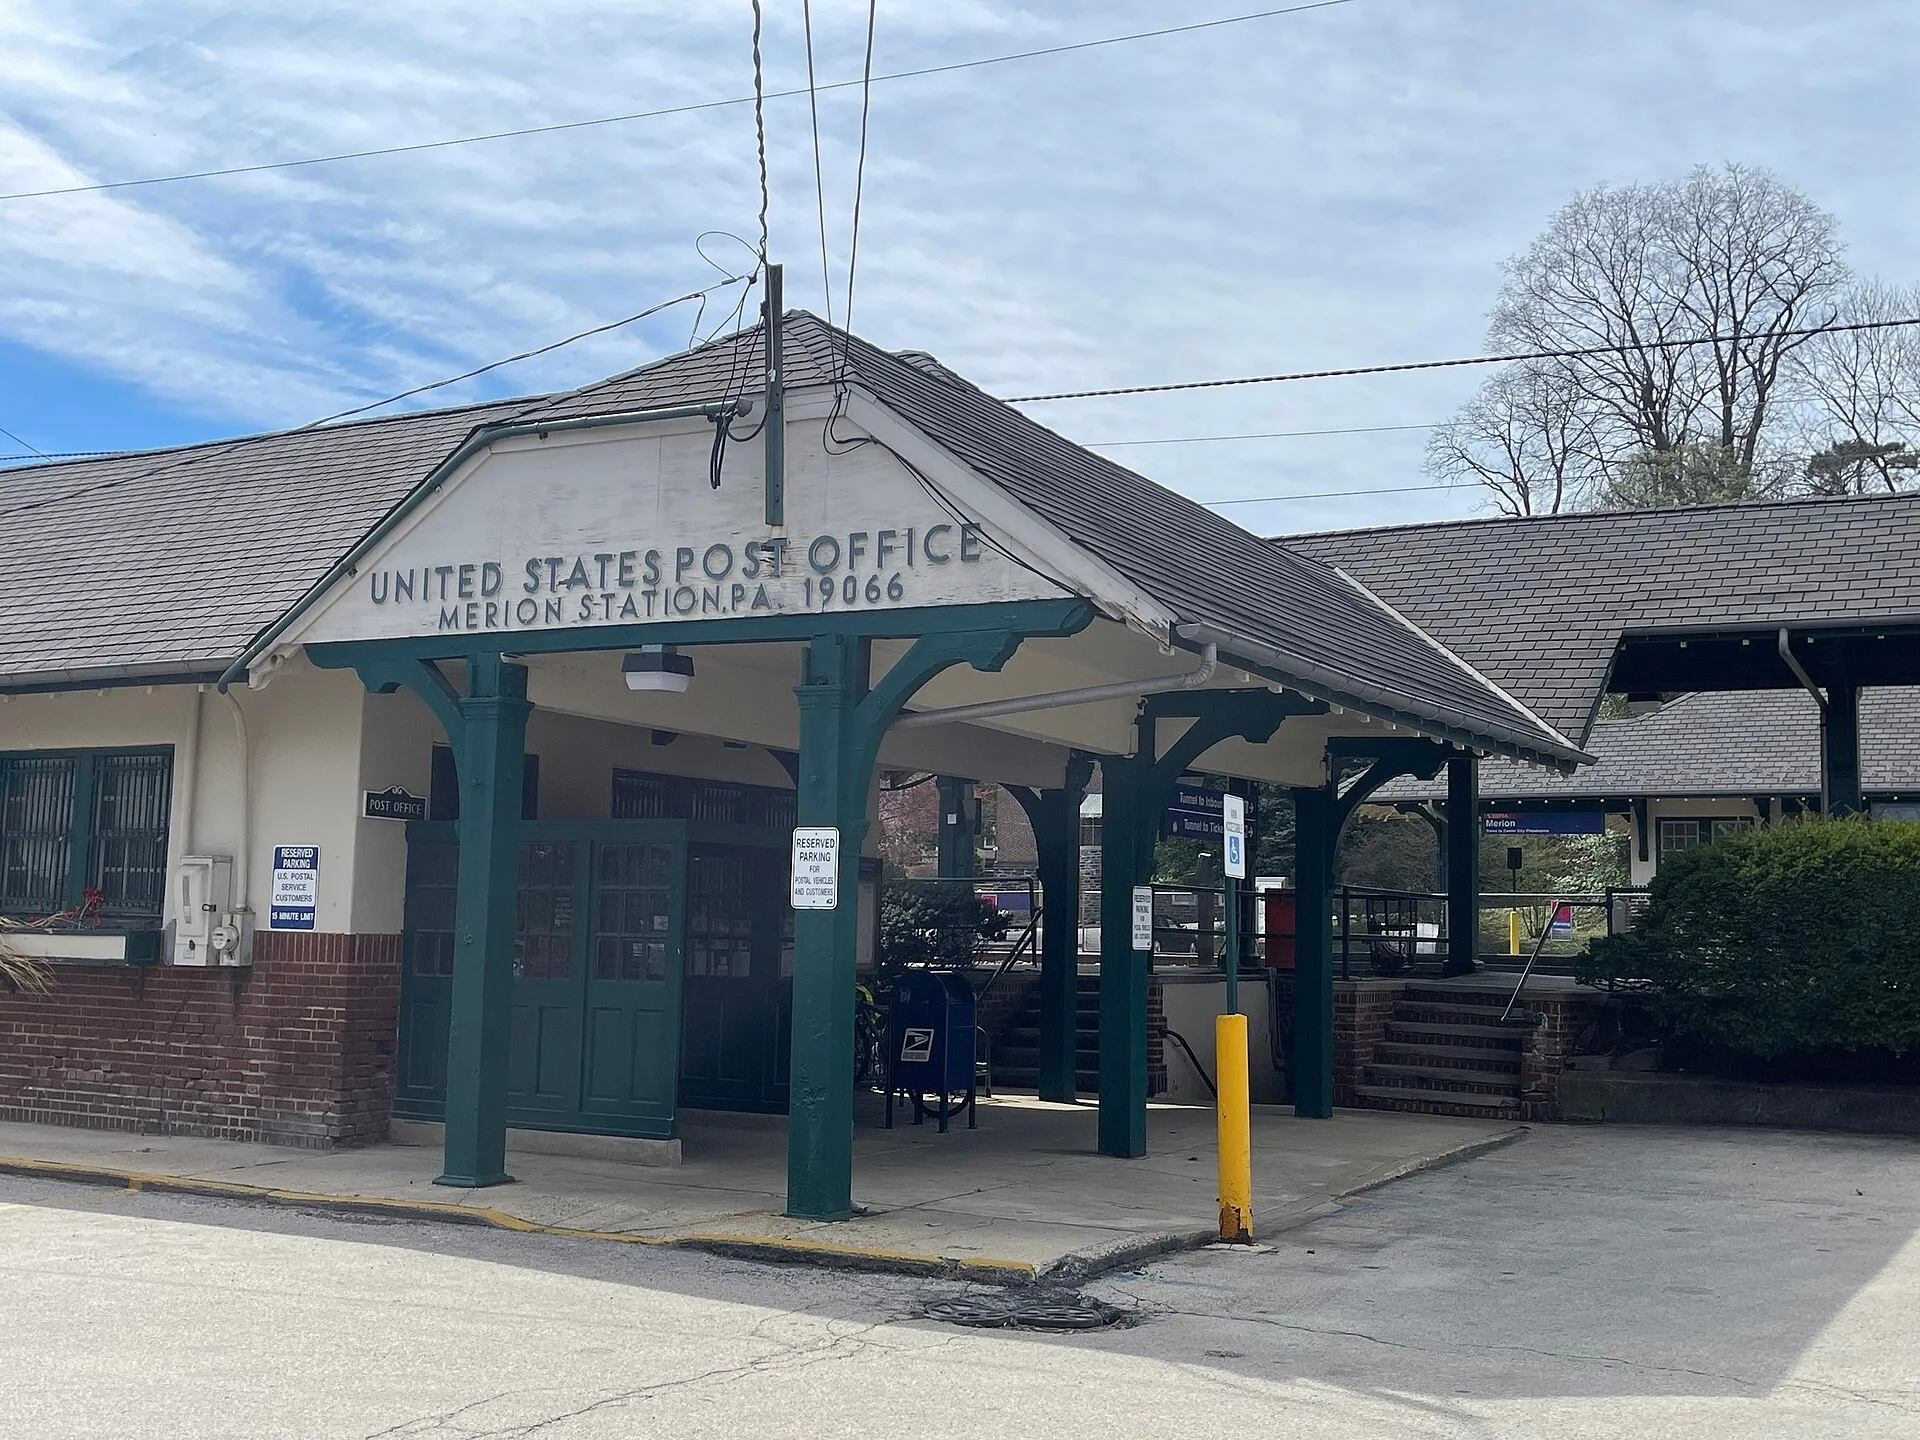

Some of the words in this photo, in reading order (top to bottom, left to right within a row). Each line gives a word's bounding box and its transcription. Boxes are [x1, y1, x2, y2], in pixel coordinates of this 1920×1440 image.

[371, 560, 502, 605] UNITED
[522, 549, 662, 594] STATES
[675, 537, 786, 583] POST
[808, 521, 982, 575] OFFICE
[438, 597, 562, 630] MERION
[803, 571, 904, 608] 19066
[370, 798, 390, 811] POST
[393, 801, 422, 815] OFFICE
[1485, 819, 1516, 827] Merion
[797, 838, 835, 848] RESERVED
[281, 848, 314, 858] RESERVED
[799, 851, 831, 862] PARKING
[283, 859, 311, 869] PARKING
[809, 865, 820, 873] FOR
[277, 872, 289, 880] U.S.
[290, 872, 314, 881] POSTAL
[281, 883, 307, 892] SERVICE
[805, 887, 834, 896] CUSTOMERS
[275, 893, 313, 903] CUSTOMERS
[278, 911, 299, 921] MINUTE
